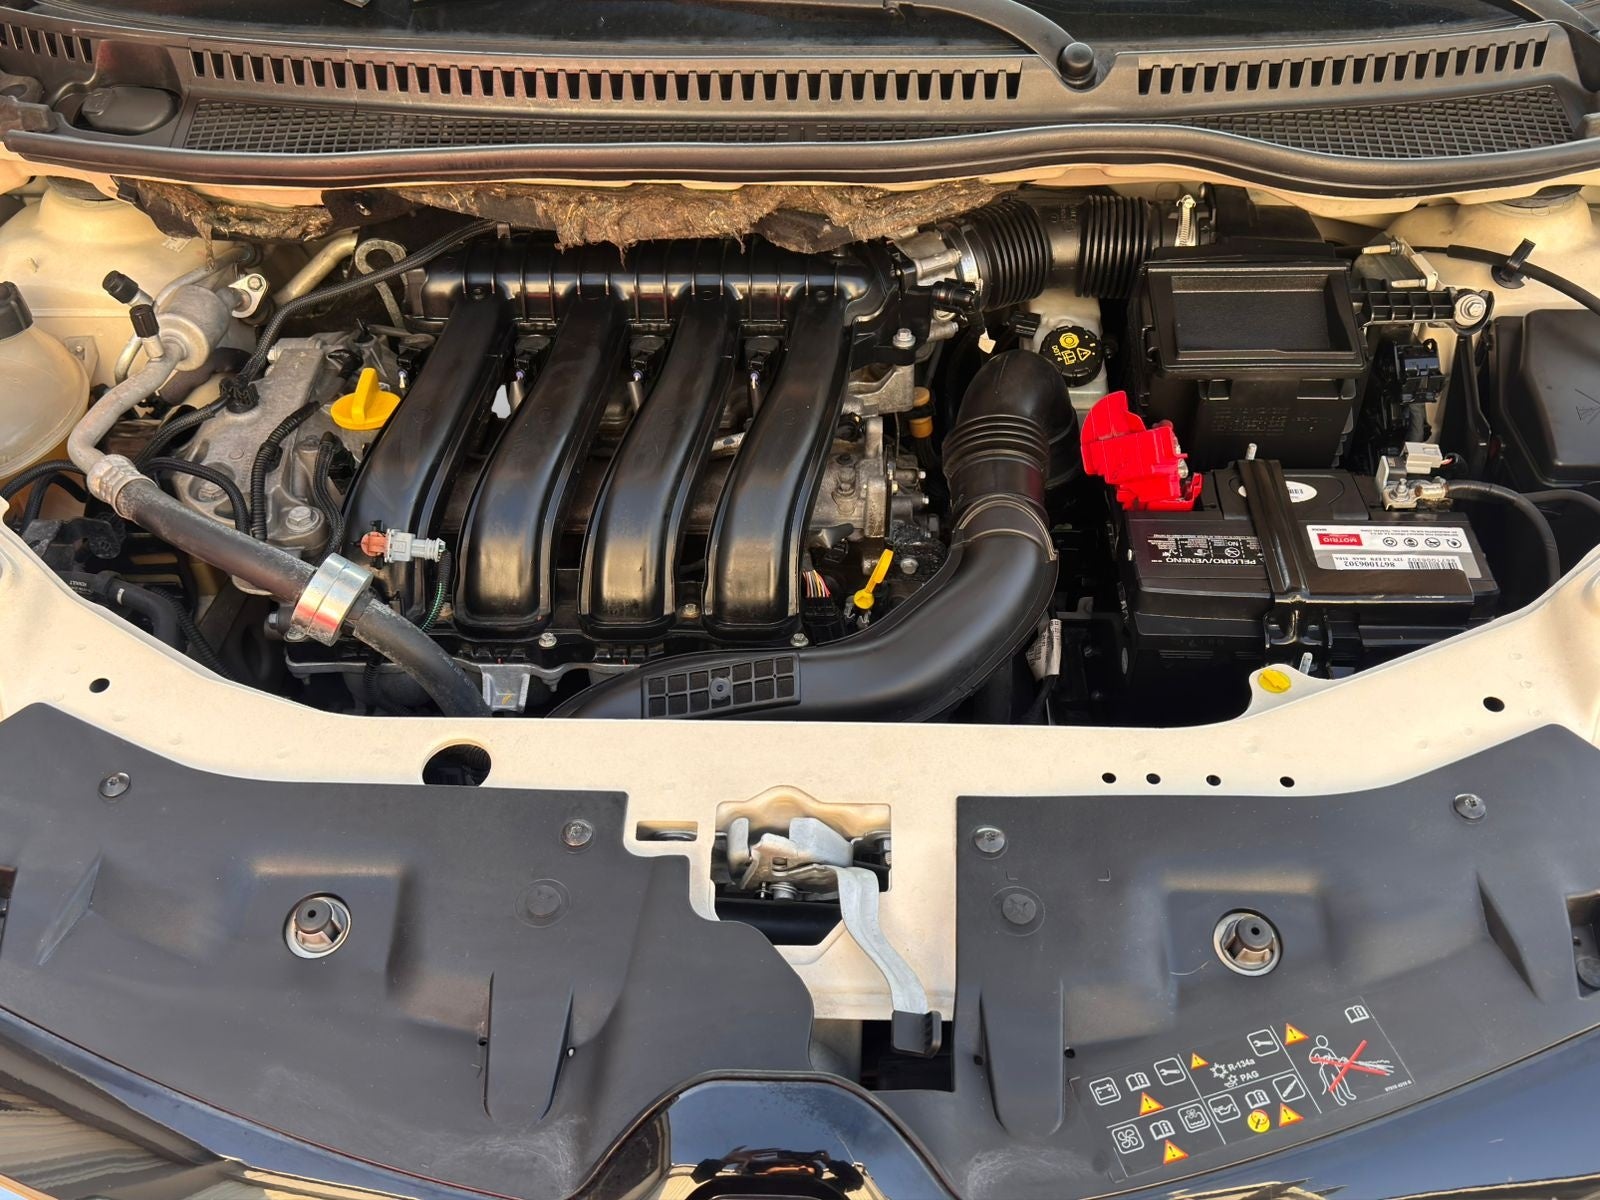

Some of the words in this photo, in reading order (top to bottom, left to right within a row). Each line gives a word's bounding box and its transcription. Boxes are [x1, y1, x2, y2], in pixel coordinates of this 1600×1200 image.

[1052, 345, 1062, 357] DOT
[1166, 557, 1257, 565] PELIGRO/VENENO
[1344, 560, 1396, 568] 8671006302
[1227, 1058, 1256, 1071] R-134a
[1240, 1070, 1260, 1082] PAG
